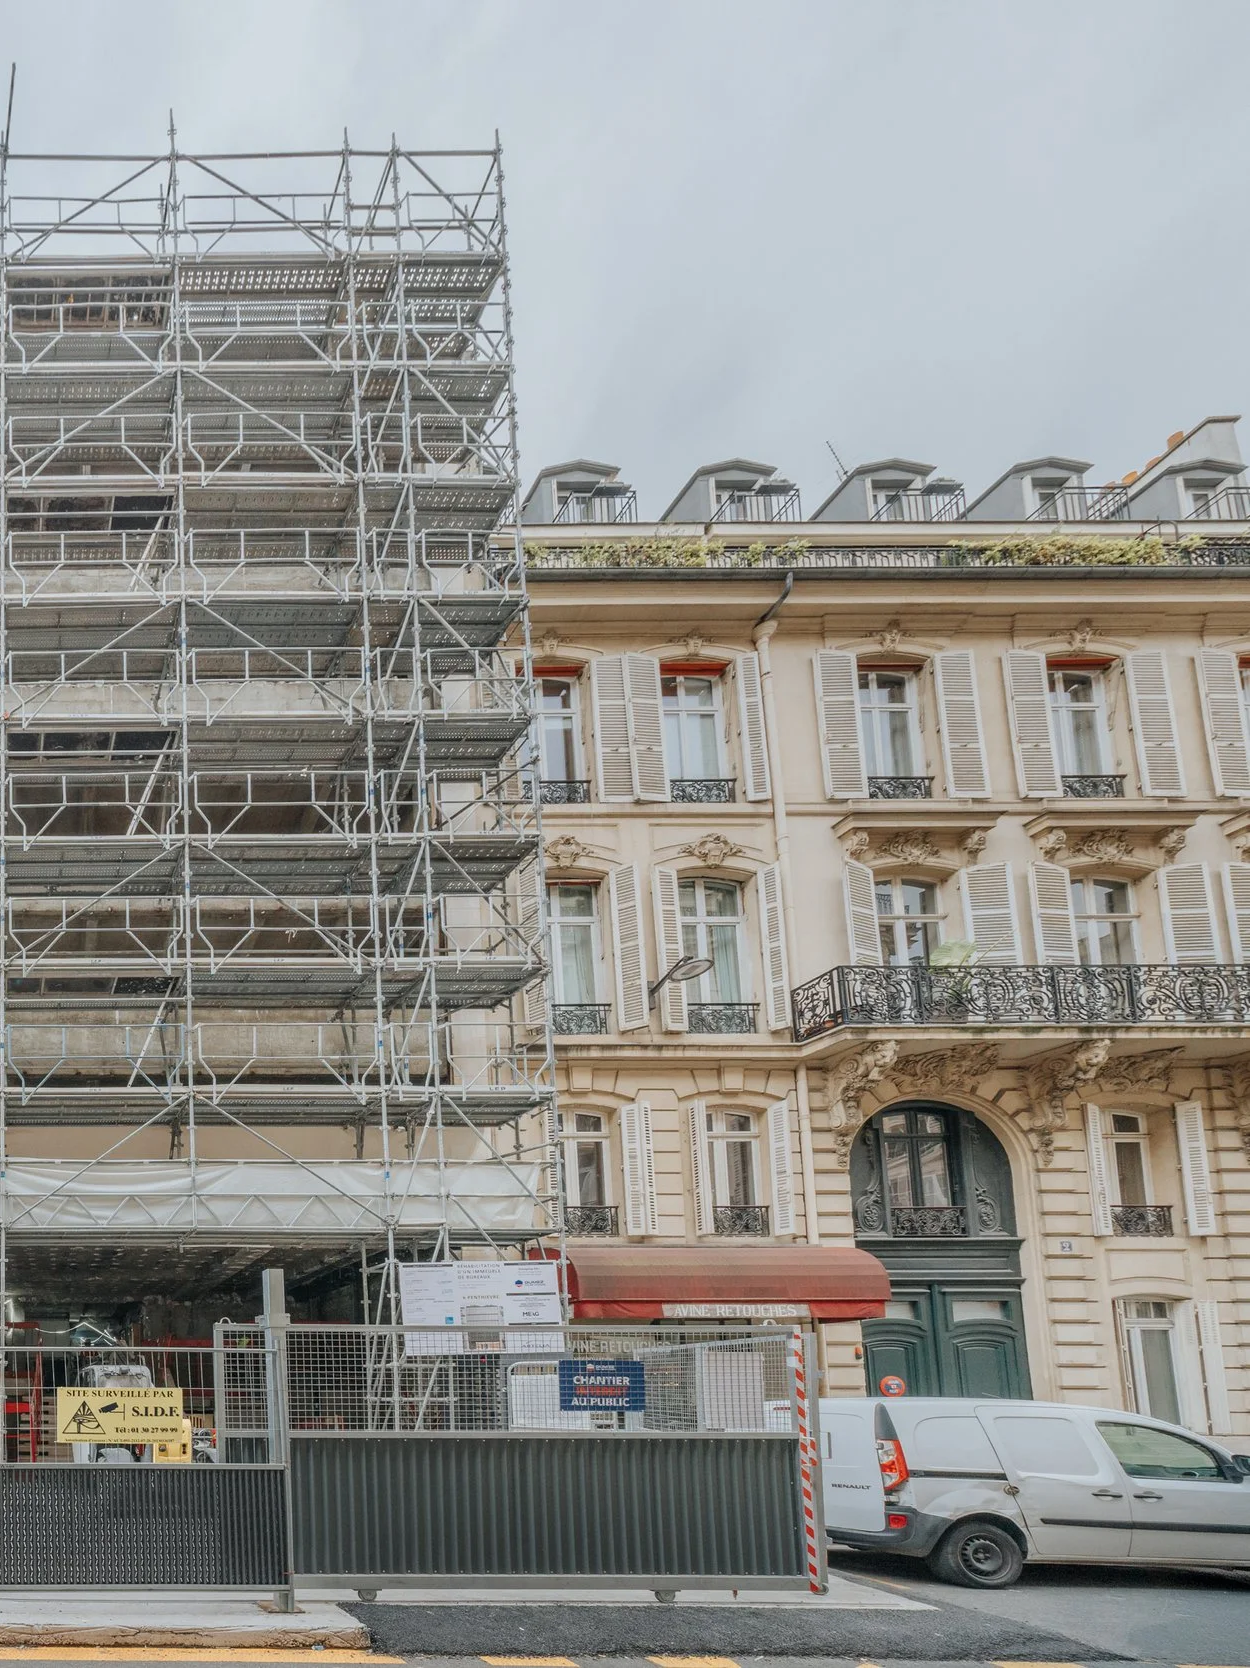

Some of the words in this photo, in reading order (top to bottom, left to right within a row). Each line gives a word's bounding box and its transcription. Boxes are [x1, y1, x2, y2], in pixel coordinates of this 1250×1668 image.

[1062, 1242, 1070, 1251] 2
[674, 1304, 710, 1317] AVINE
[716, 1304, 797, 1317] RETOUCHES
[573, 1375, 630, 1385] CHANTIER
[91, 1388, 151, 1398] SURVEILLÉ
[153, 1390, 174, 1398] PAR
[575, 1386, 629, 1396] INTERDIT
[571, 1397, 587, 1406] AU
[590, 1397, 630, 1407] PUBLIC
[131, 1406, 180, 1417] S.I.D.F.
